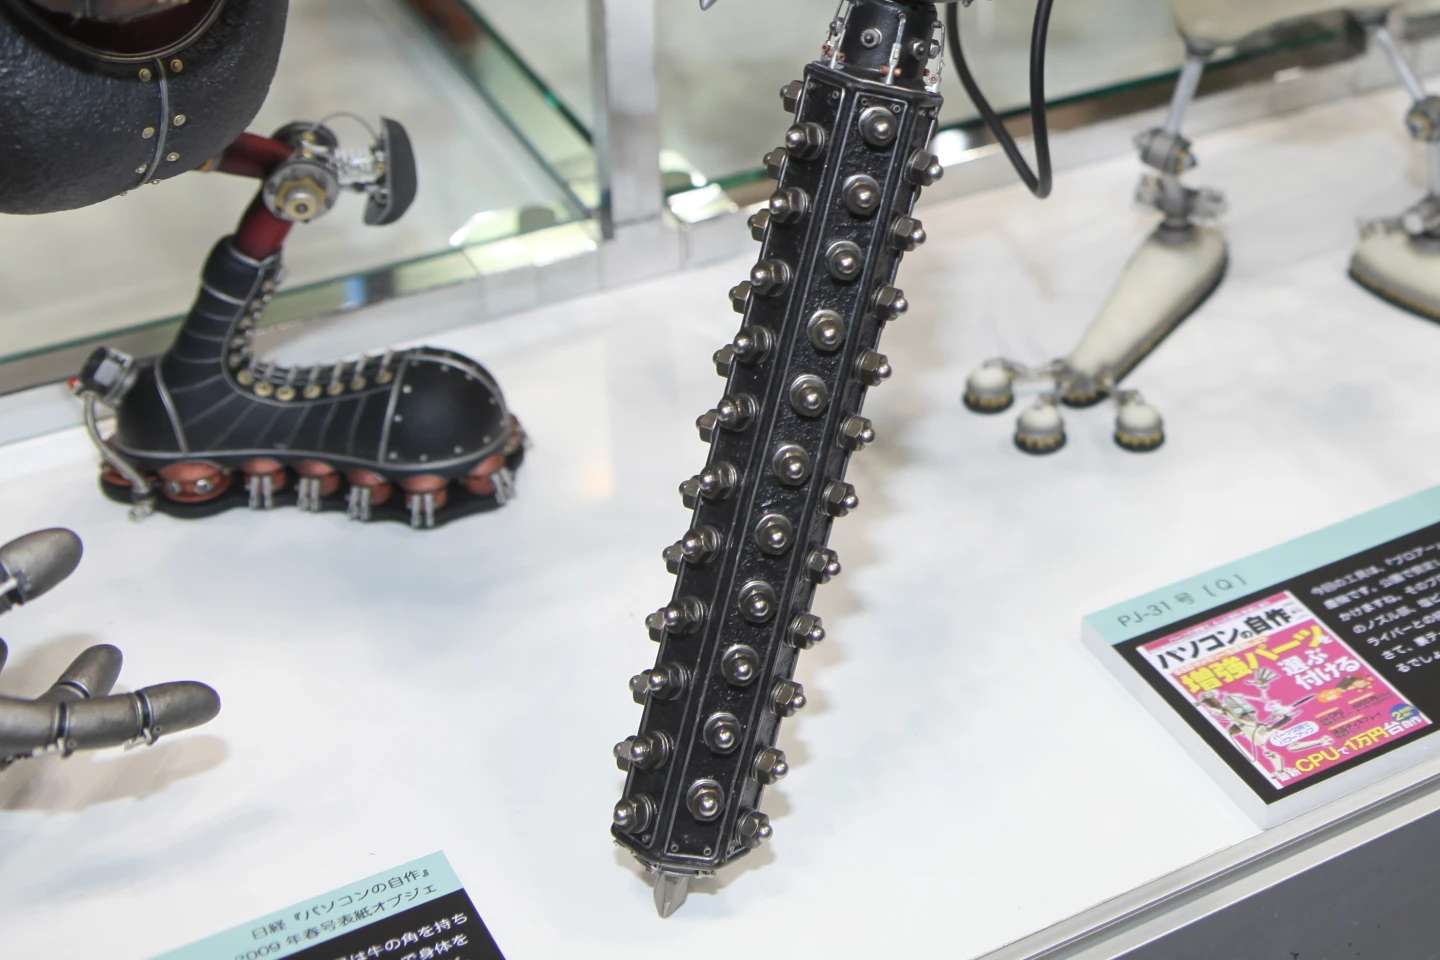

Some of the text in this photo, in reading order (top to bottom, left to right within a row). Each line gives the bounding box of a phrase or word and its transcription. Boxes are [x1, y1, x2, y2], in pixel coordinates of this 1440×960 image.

[1116, 600, 1174, 627] PJ-31
[1149, 605, 1296, 672] パソコンの自作
[1275, 645, 1332, 675] 選ぶ
[1289, 652, 1364, 692] 付ける
